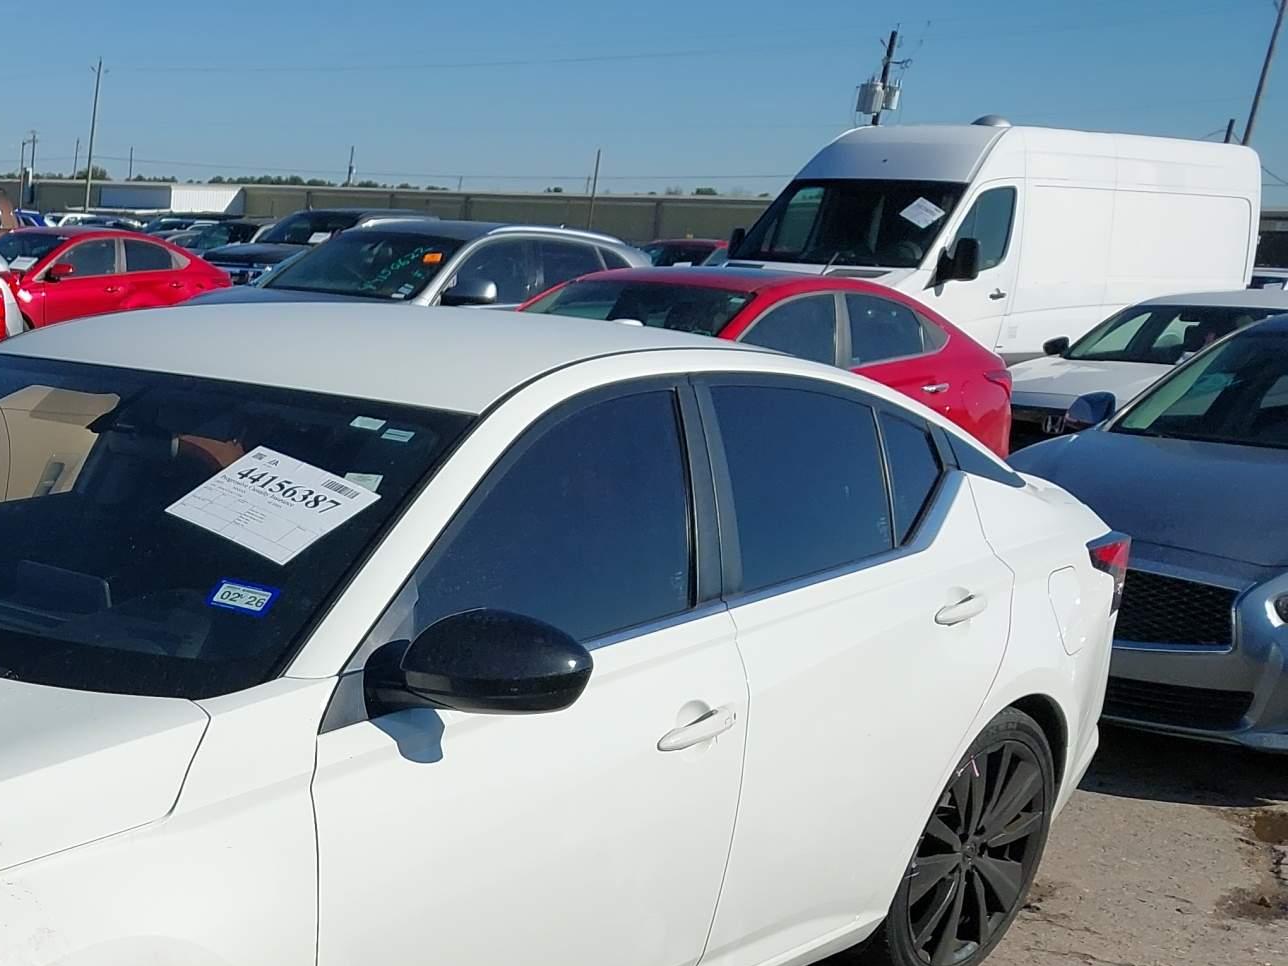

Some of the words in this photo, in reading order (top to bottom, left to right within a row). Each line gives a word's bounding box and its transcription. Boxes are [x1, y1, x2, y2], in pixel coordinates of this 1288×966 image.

[237, 467, 341, 513] 44156387
[220, 590, 241, 602] 02
[245, 596, 266, 608] 26
